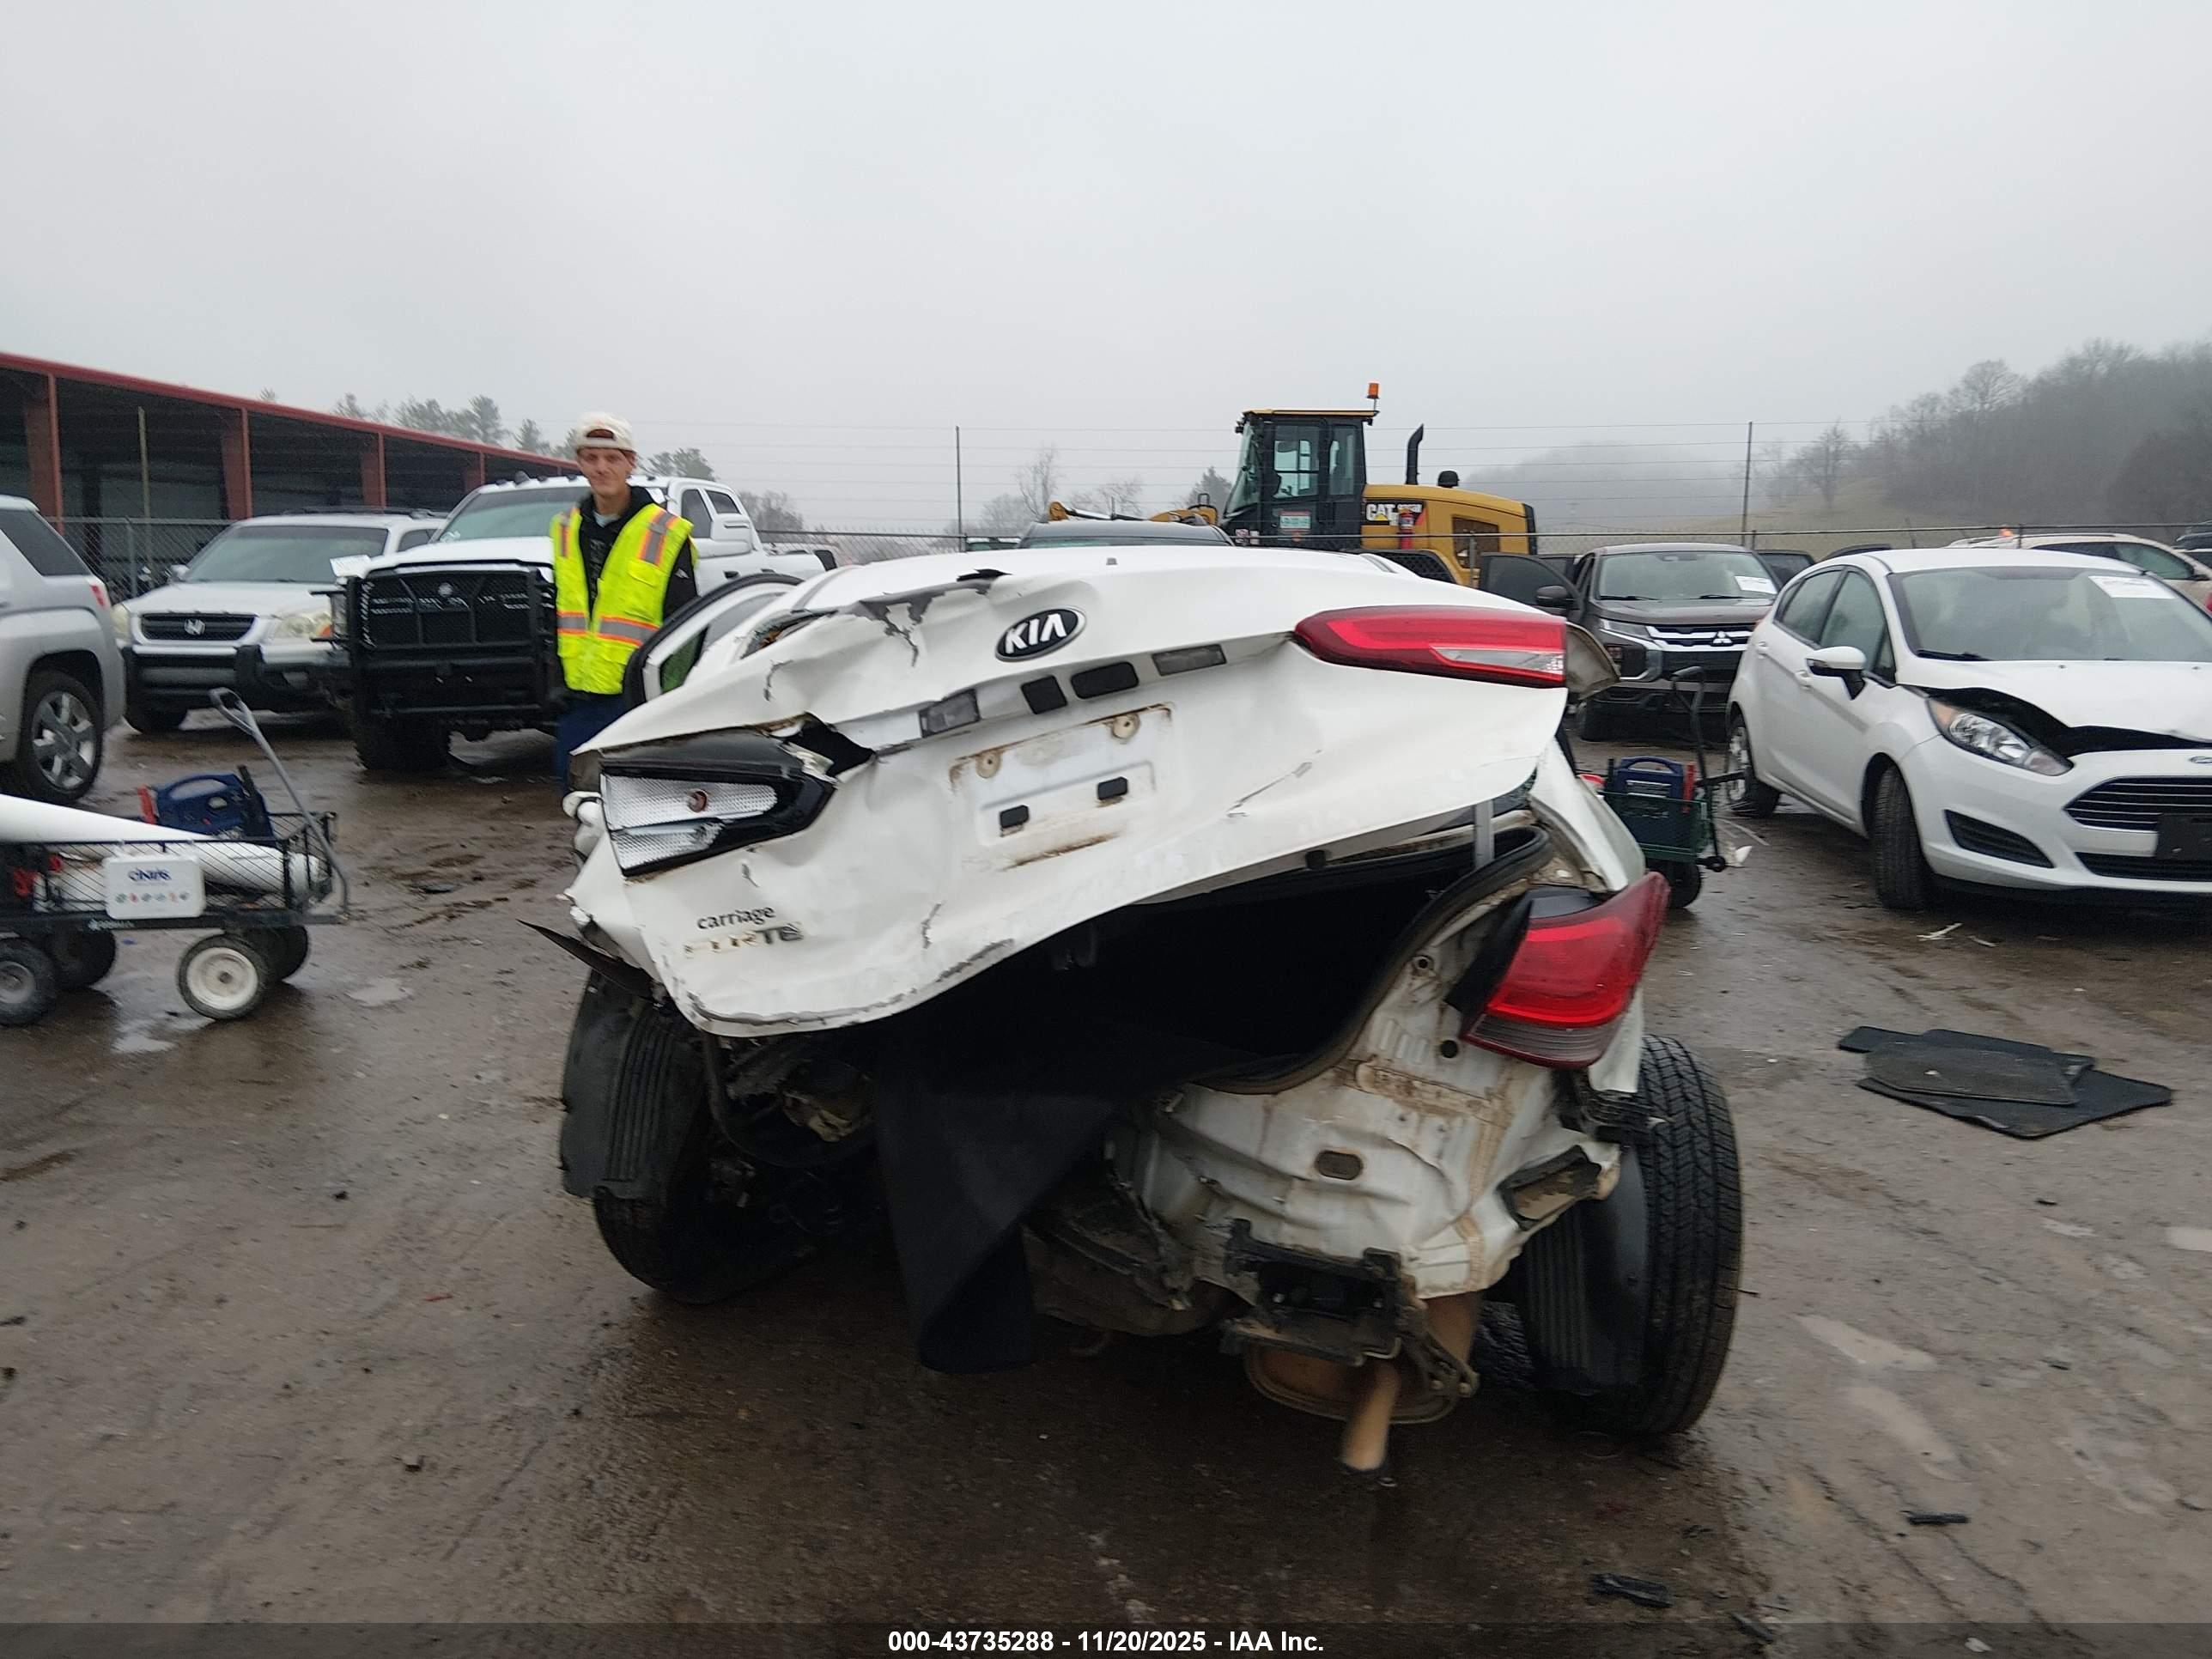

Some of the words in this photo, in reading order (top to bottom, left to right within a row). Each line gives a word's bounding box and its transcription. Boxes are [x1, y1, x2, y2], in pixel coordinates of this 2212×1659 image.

[1366, 503, 1395, 521] CAT
[1005, 612, 1067, 654] KIA
[696, 906, 776, 930] carriage
